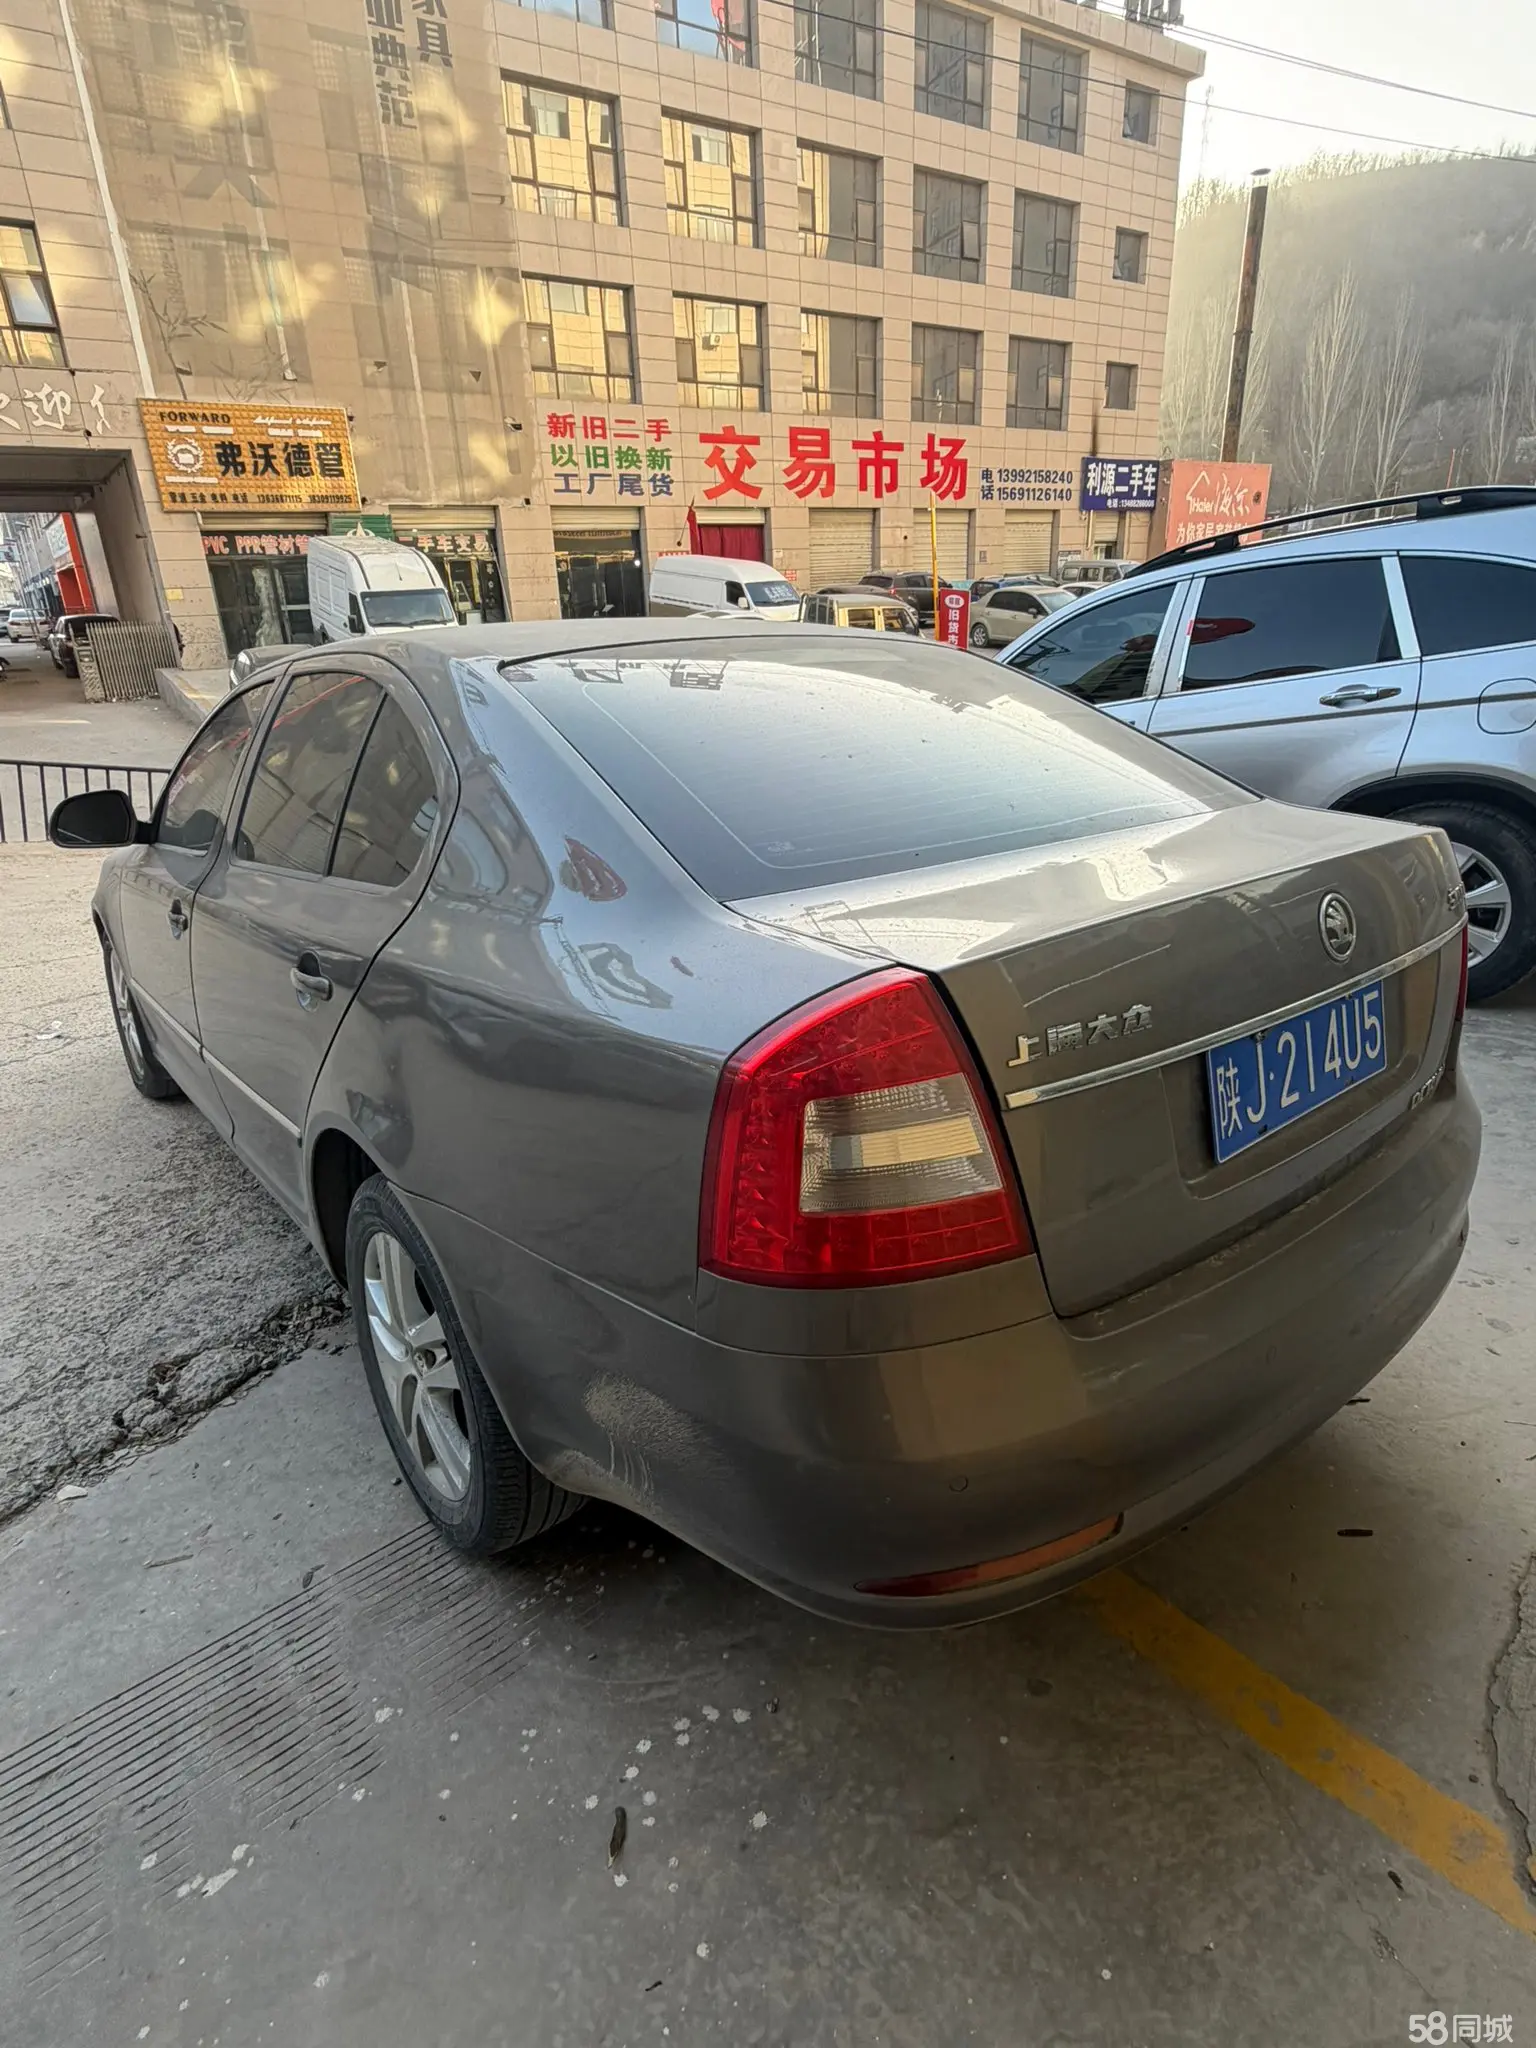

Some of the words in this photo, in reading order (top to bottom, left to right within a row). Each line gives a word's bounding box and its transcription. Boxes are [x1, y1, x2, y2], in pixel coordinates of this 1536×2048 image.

[159, 411, 231, 425] FORWARD
[547, 412, 672, 442] 新旧二手
[550, 443, 673, 471] 以旧换新
[698, 425, 969, 501] 交易市场
[553, 473, 674, 497] 工厂尾货
[997, 468, 1073, 484] 13992158240
[1086, 461, 1158, 497] 利源二手车
[997, 486, 1072, 501] 15691126140
[202, 535, 230, 555] PVC
